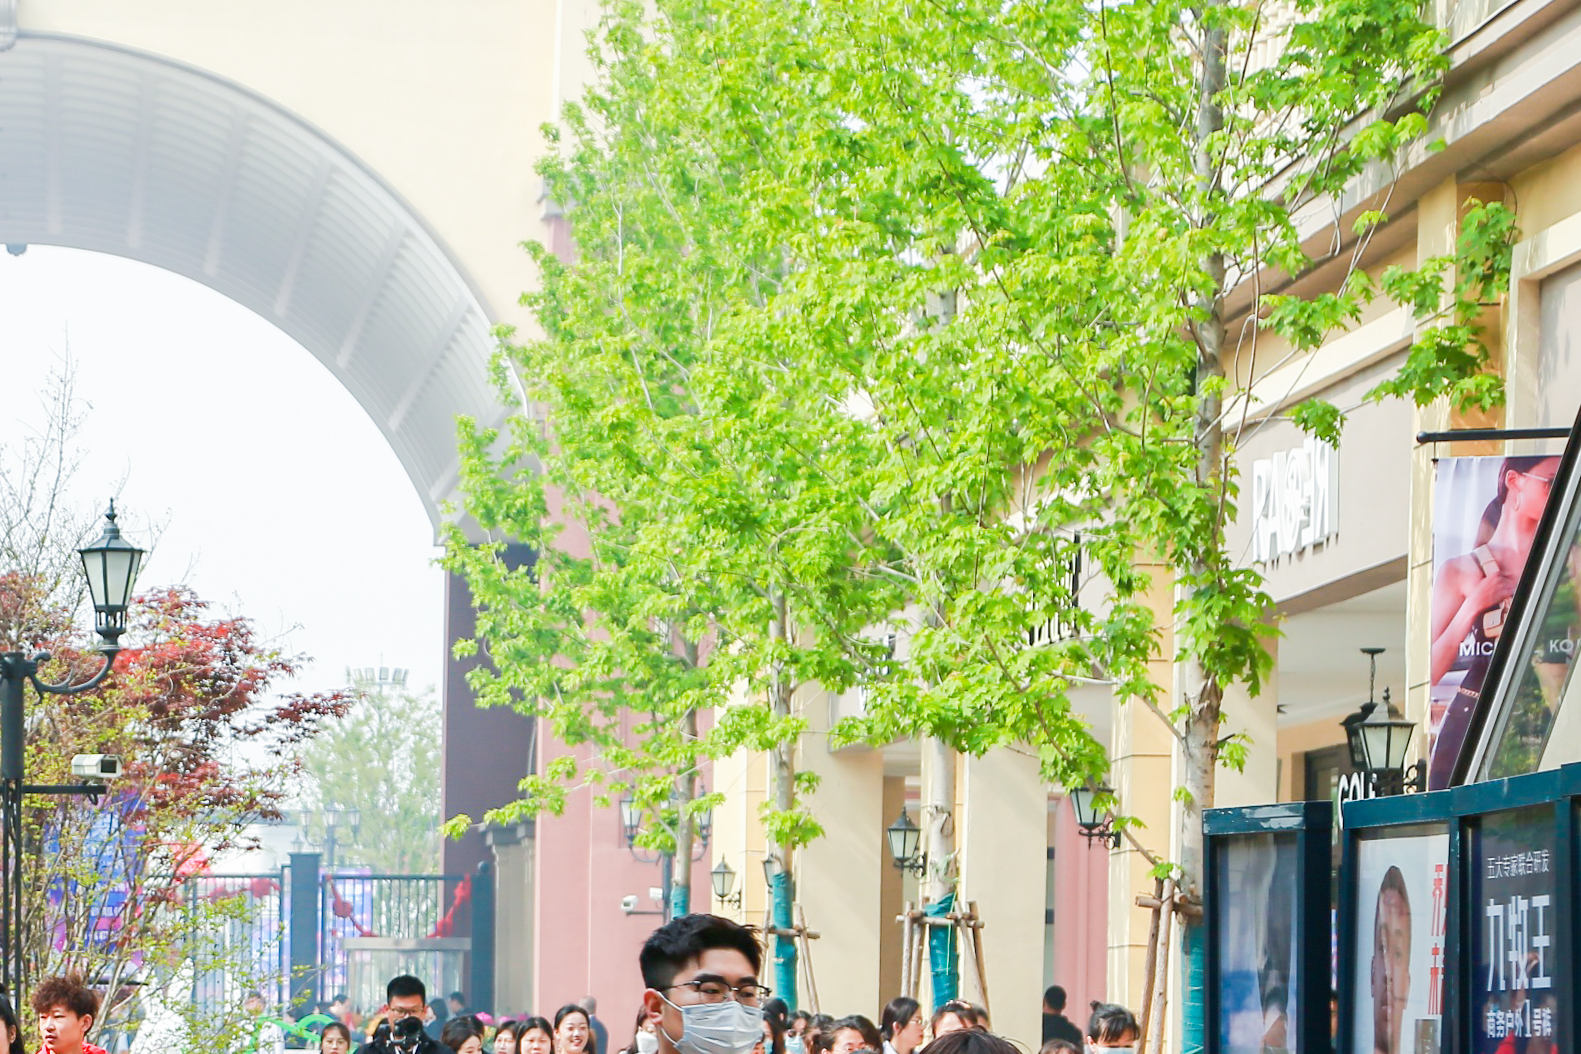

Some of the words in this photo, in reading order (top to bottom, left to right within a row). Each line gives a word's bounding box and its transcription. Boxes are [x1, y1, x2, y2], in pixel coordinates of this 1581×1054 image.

[1459, 641, 1498, 657] MIC
[1487, 849, 1549, 879] 五大专家联合研发
[1486, 895, 1551, 992] 九牧王
[1487, 999, 1551, 1038] 商务户外1号裤
